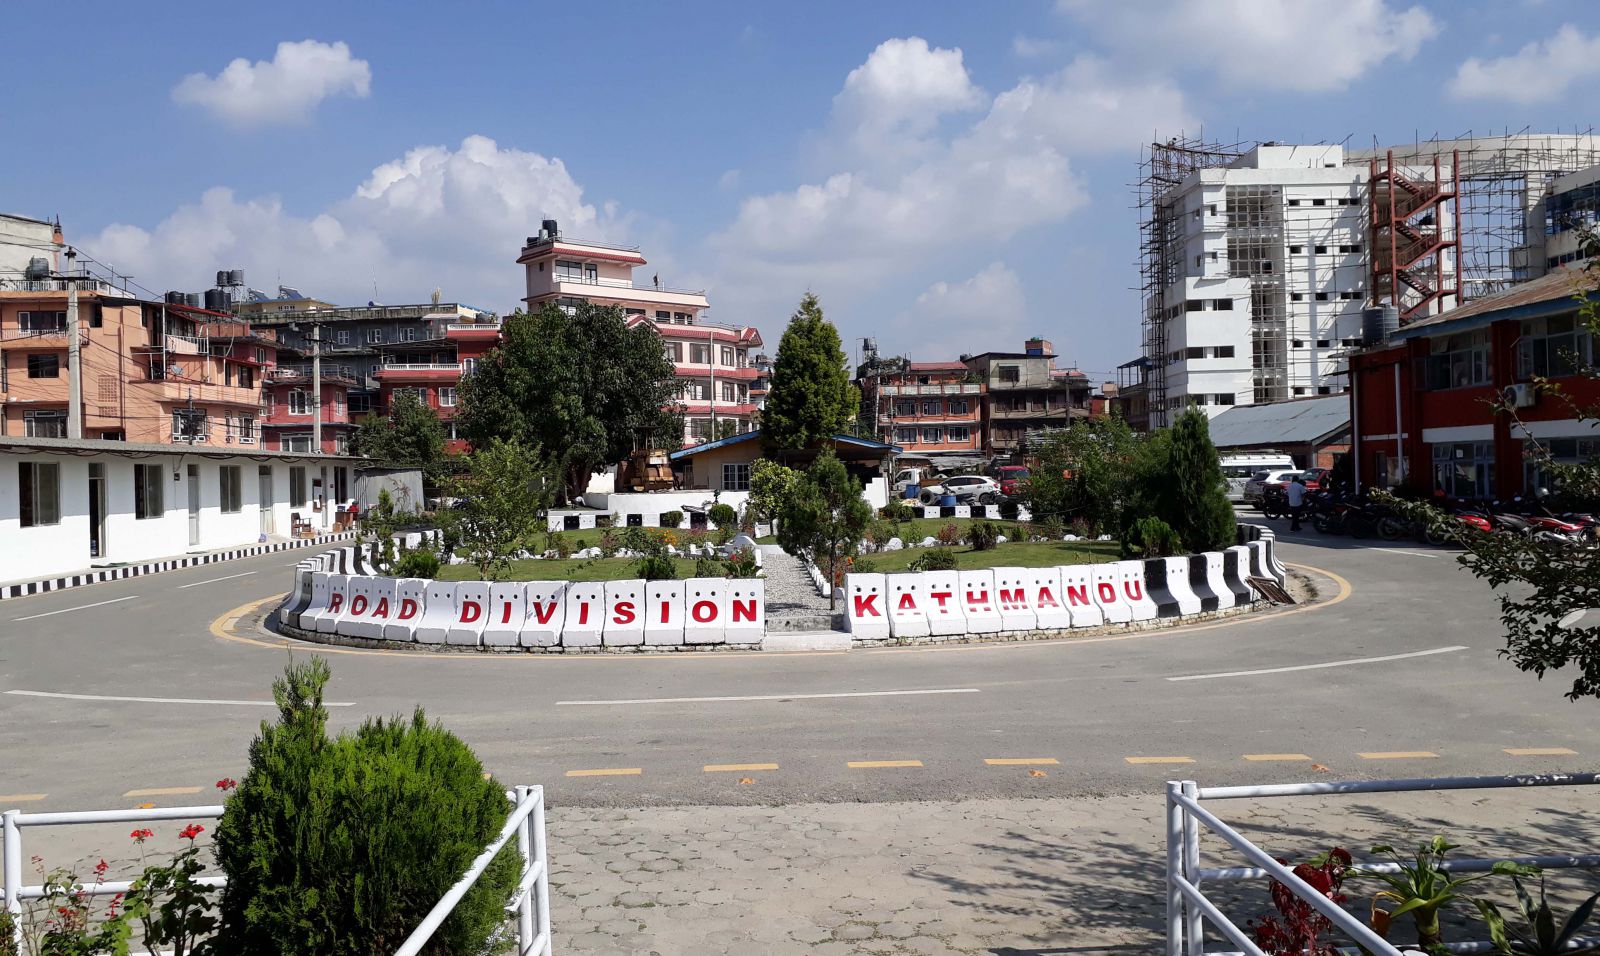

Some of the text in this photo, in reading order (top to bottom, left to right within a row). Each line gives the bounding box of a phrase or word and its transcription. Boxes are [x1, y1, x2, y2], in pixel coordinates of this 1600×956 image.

[328, 580, 1143, 625] ROAD DIVISION KATHMANDU
